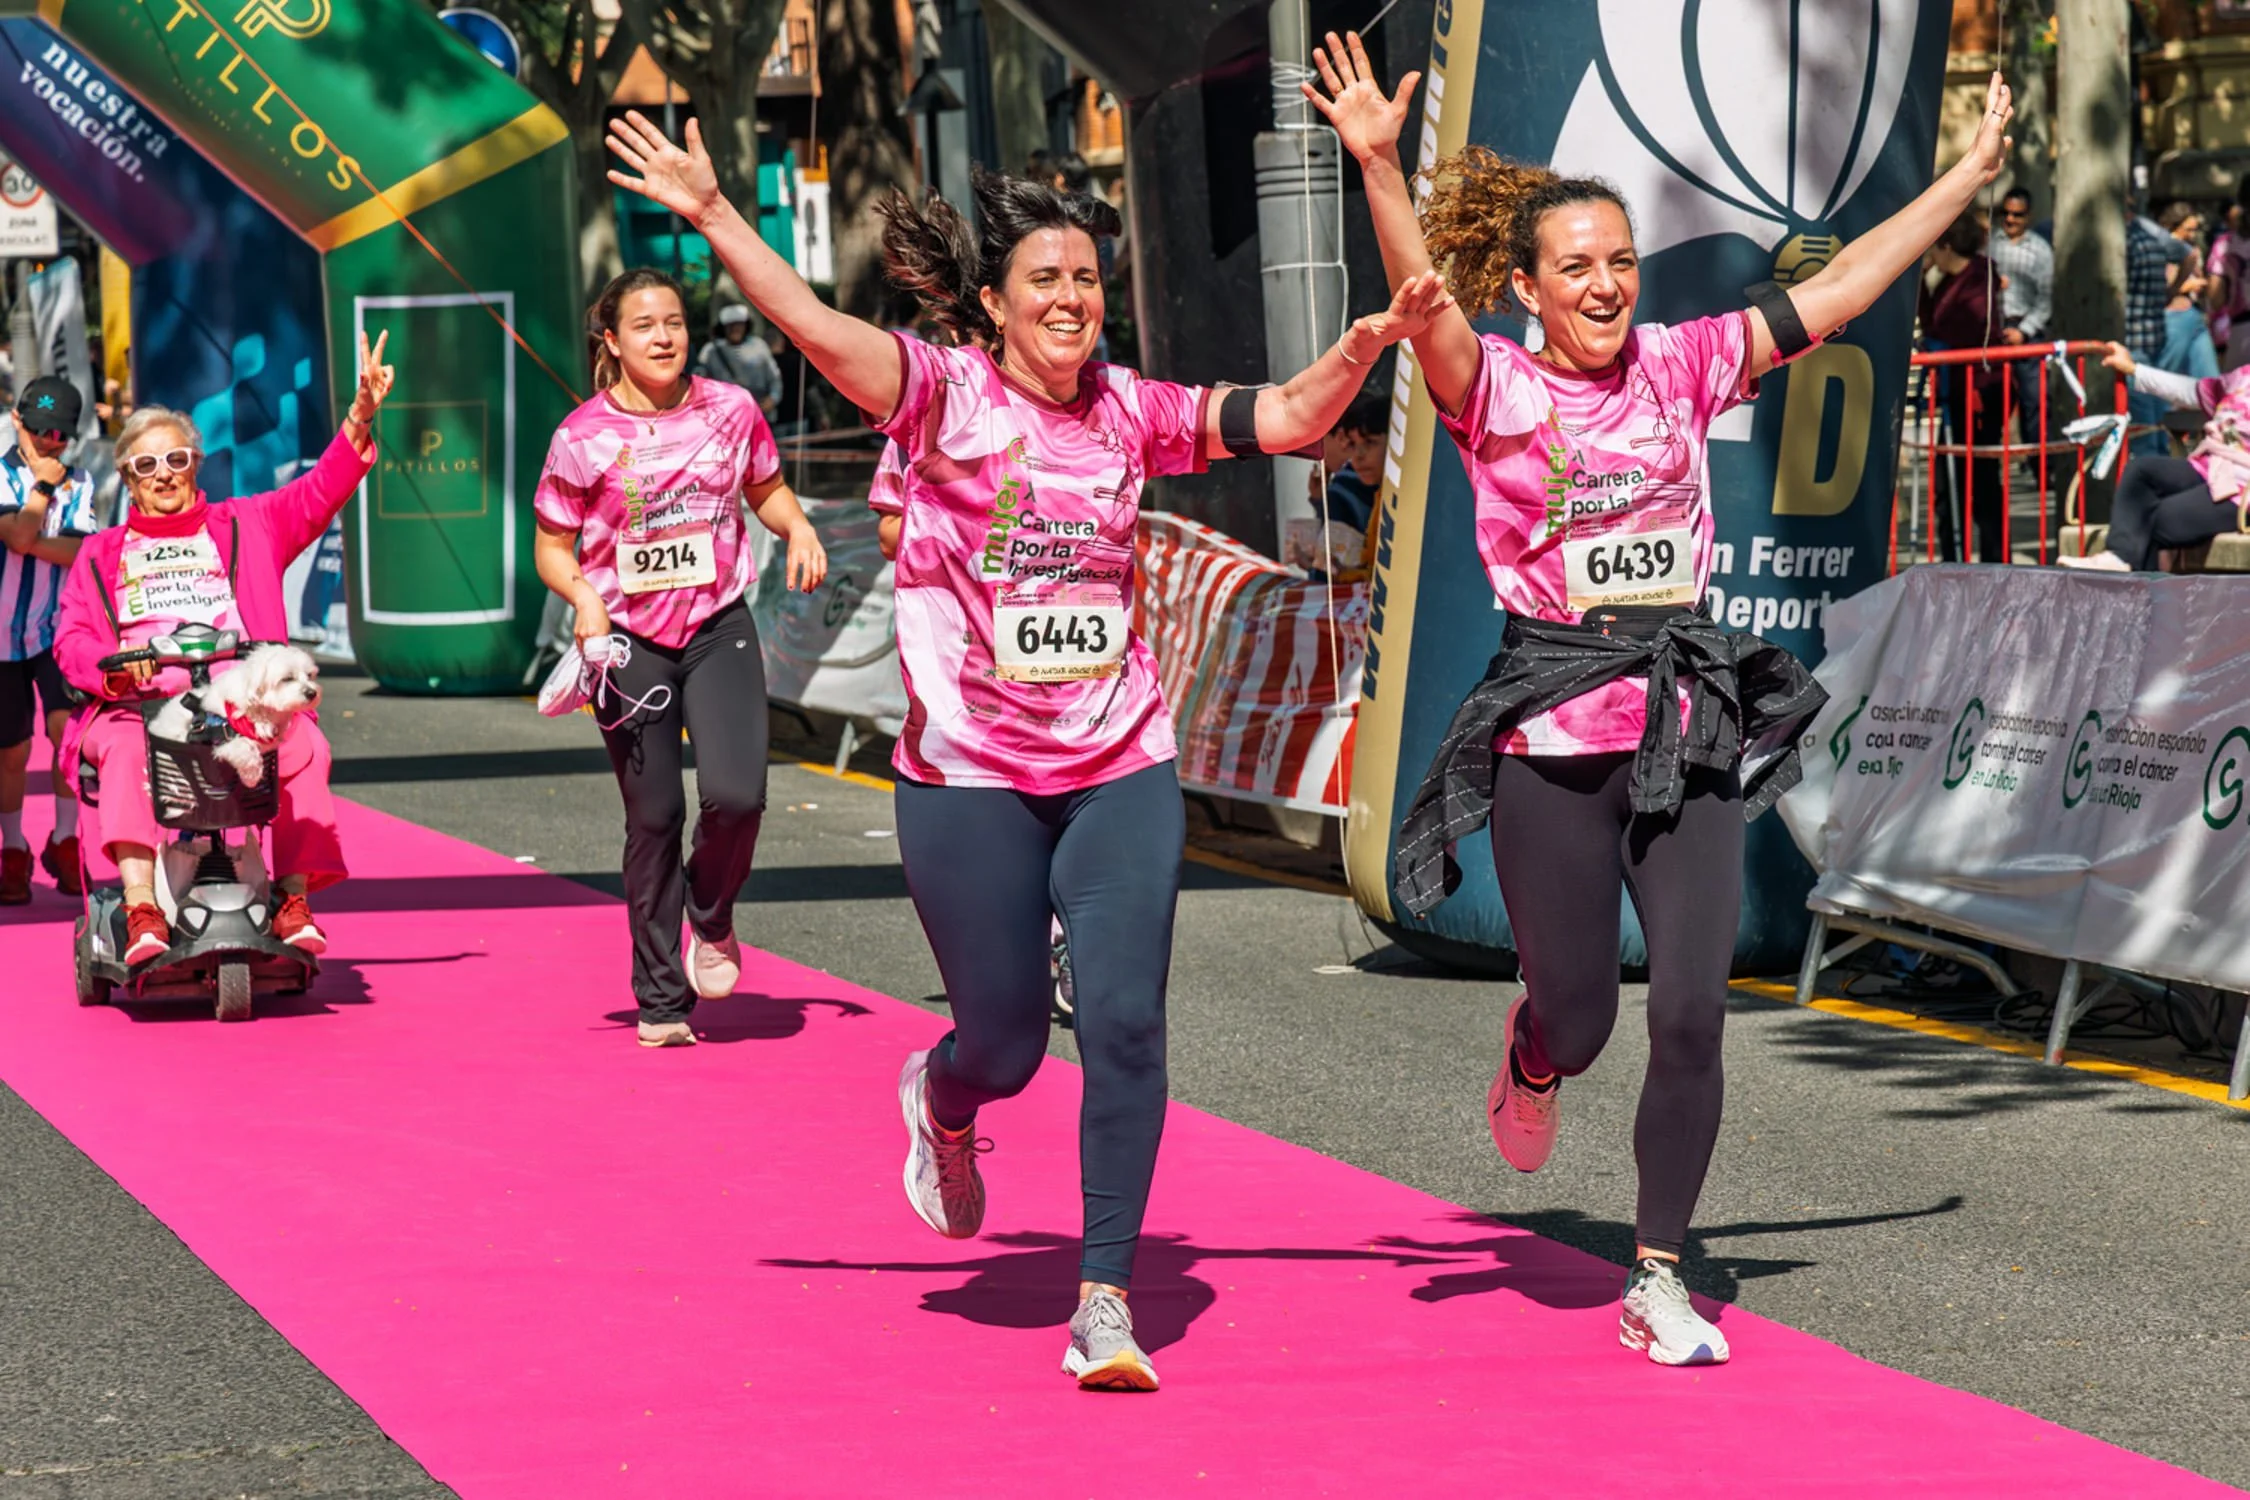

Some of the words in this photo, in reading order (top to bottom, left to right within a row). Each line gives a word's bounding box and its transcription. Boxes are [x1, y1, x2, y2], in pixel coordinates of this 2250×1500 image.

[41, 40, 169, 159] nuestra
[137, 0, 361, 191] TILLOS
[20, 60, 145, 183] vocación.
[4, 173, 36, 195] 30
[640, 474, 655, 488] XI
[643, 482, 699, 504] Carrera
[1542, 442, 1572, 537] mujer
[1571, 468, 1644, 489] Carrera
[644, 507, 670, 524] por
[670, 502, 684, 515] la
[1571, 500, 1604, 519] por
[1611, 494, 1628, 510] la
[982, 472, 1021, 574] mujer
[1019, 509, 1095, 536] Carrera
[143, 543, 197, 562] 1256
[634, 543, 697, 574] 9214
[1010, 538, 1048, 558] por
[1051, 541, 1071, 559] la
[1587, 539, 1675, 586] 6439
[1749, 536, 1855, 578] Ferrer
[145, 585, 175, 598] por
[176, 581, 192, 593] la
[1703, 586, 1835, 637] Deport
[1017, 615, 1107, 655] 6443
[2123, 754, 2139, 777] el
[2139, 757, 2179, 782] cáncer
[2109, 783, 2141, 814] Rioja
